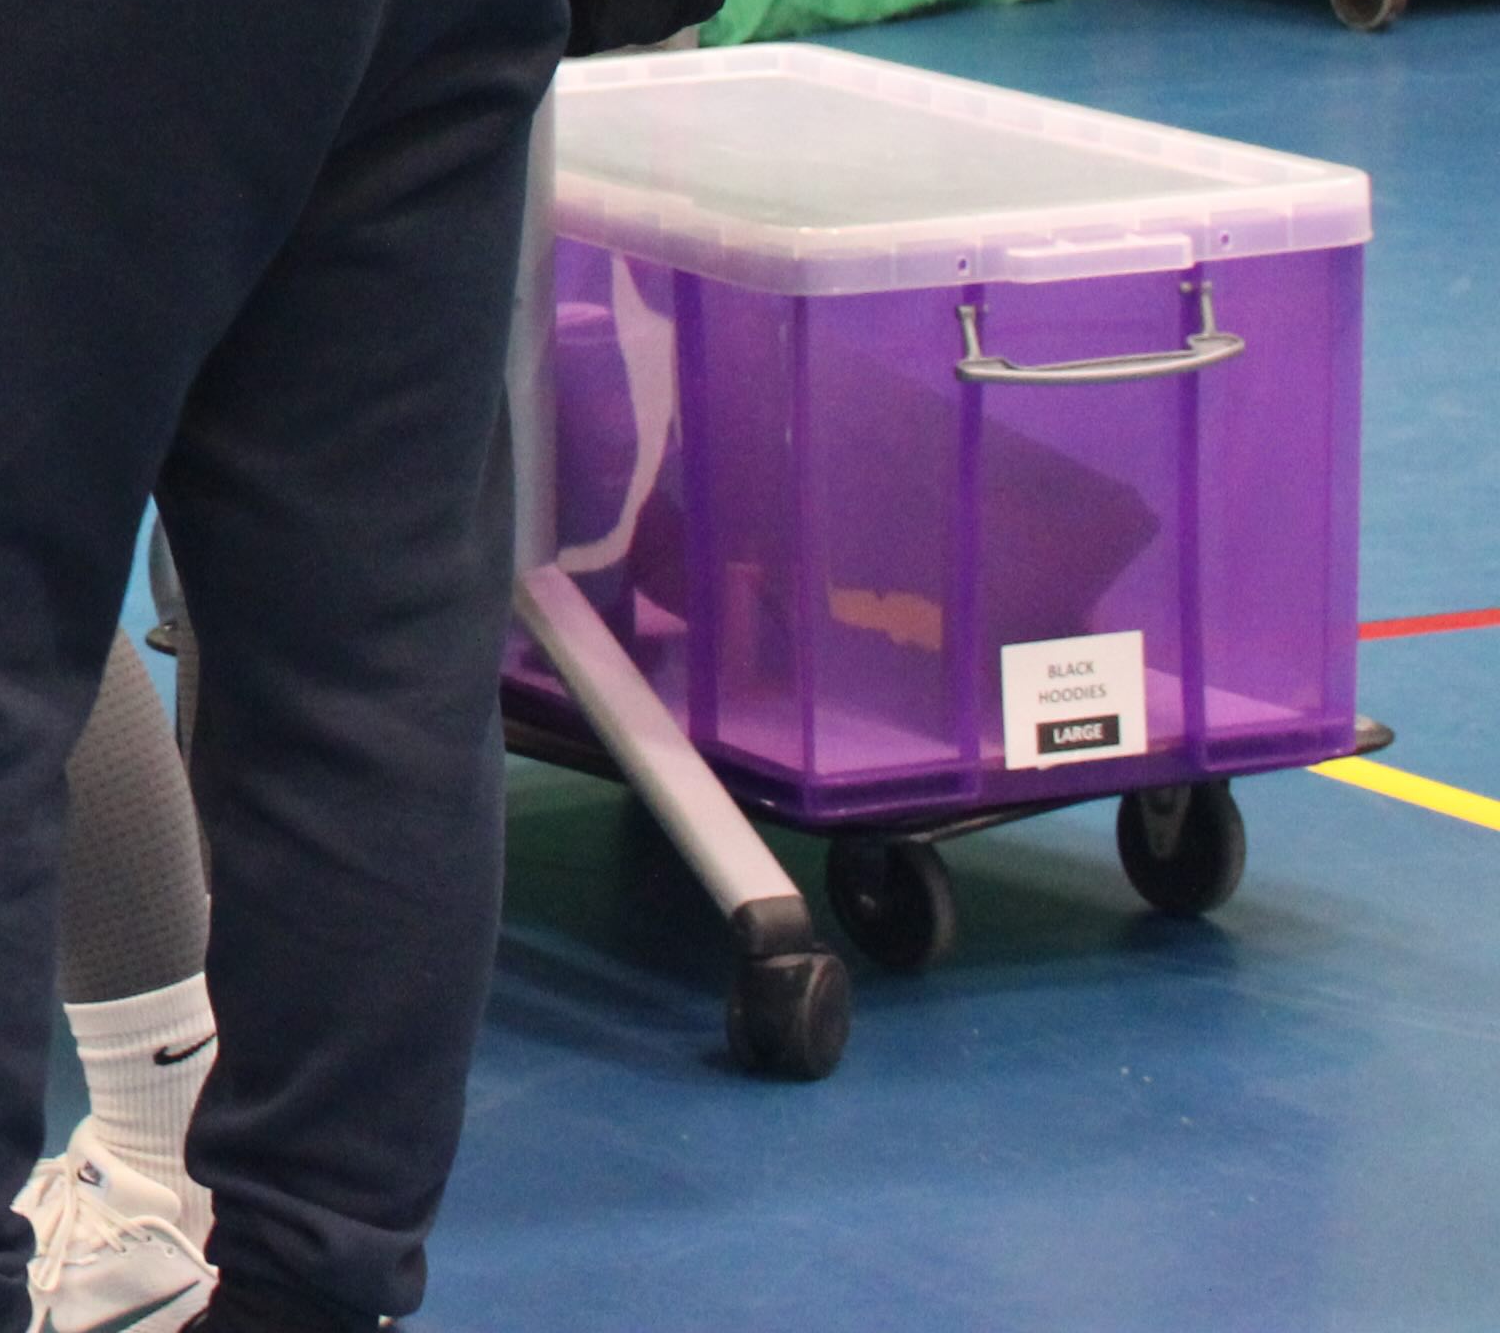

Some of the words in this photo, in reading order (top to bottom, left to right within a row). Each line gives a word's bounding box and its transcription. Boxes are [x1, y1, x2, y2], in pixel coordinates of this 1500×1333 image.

[1047, 660, 1096, 680] BLACK
[1038, 683, 1108, 705] HOODIES
[1052, 722, 1104, 745] LARGE
